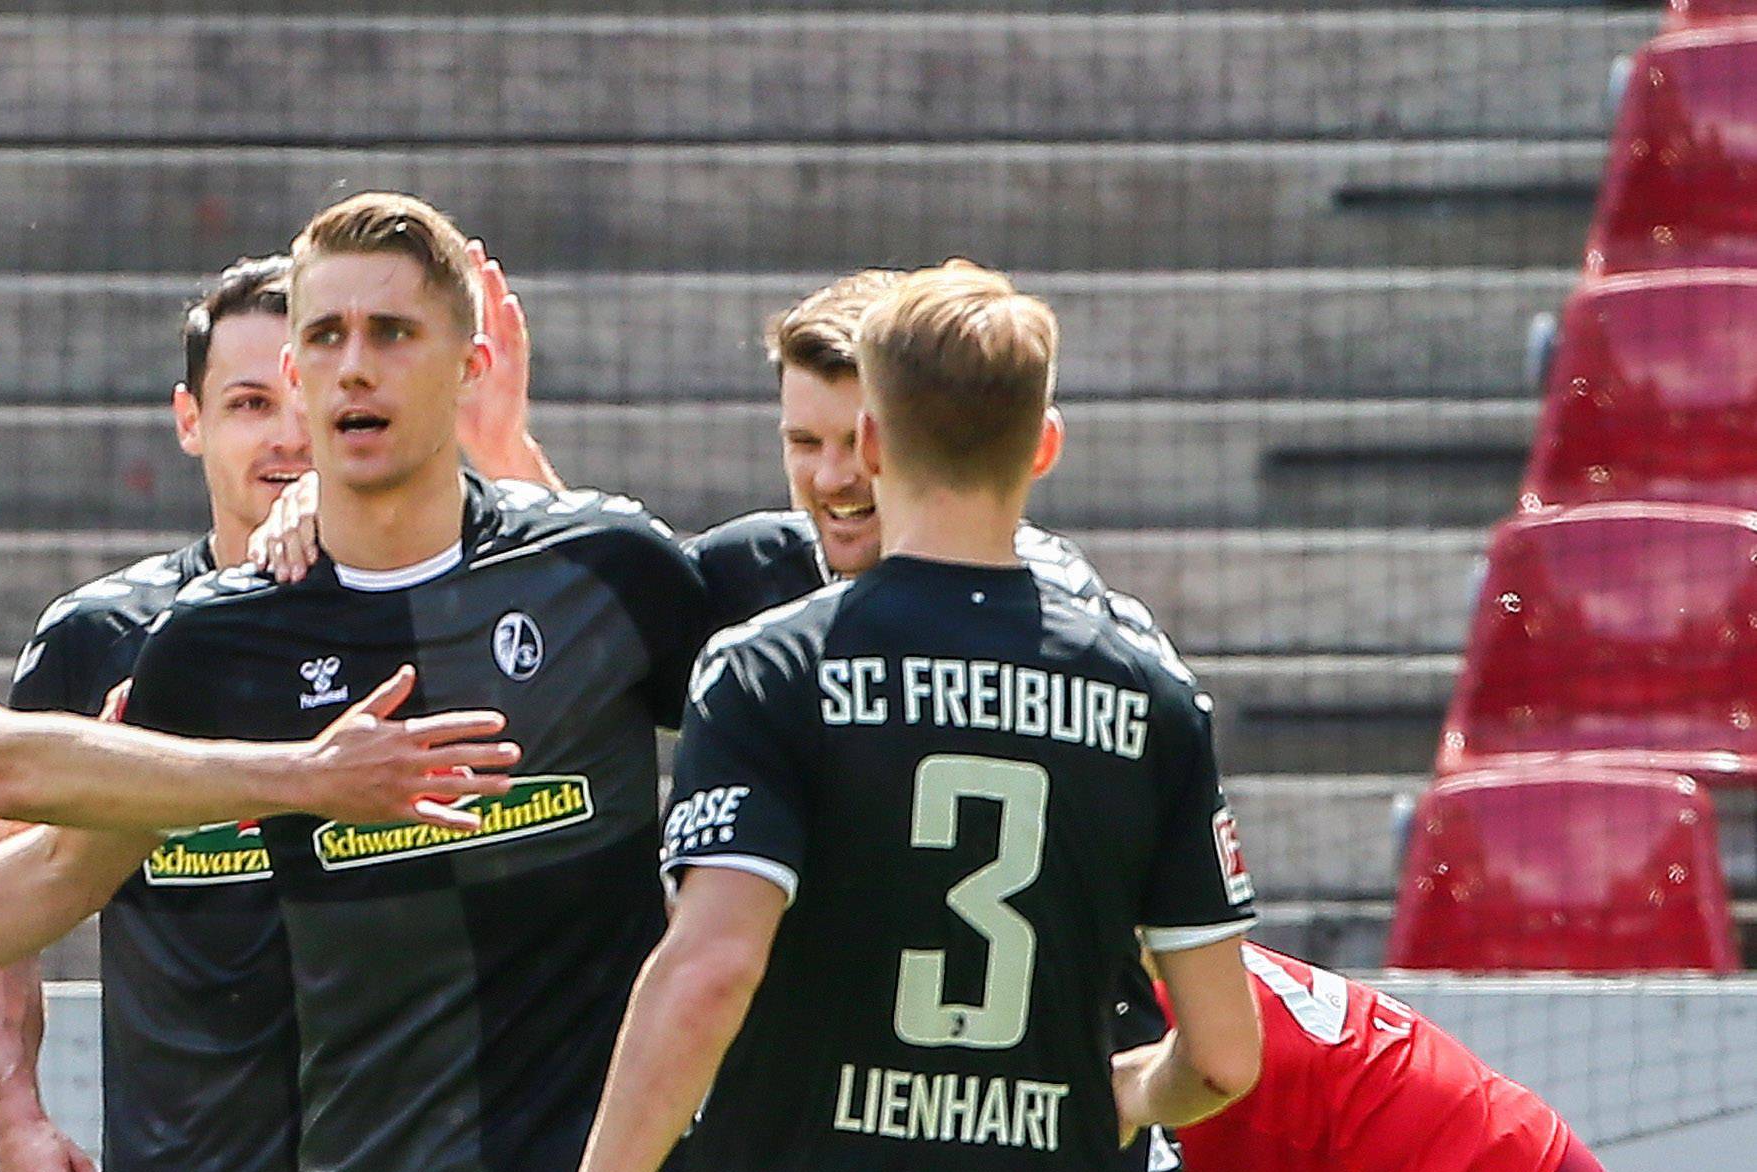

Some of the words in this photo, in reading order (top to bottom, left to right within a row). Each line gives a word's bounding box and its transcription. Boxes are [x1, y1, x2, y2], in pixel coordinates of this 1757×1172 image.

[818, 656, 888, 726] SC
[902, 657, 1149, 760] FREIBURG
[893, 753, 1050, 1050] 3
[833, 1063, 1070, 1152] LIENHART
